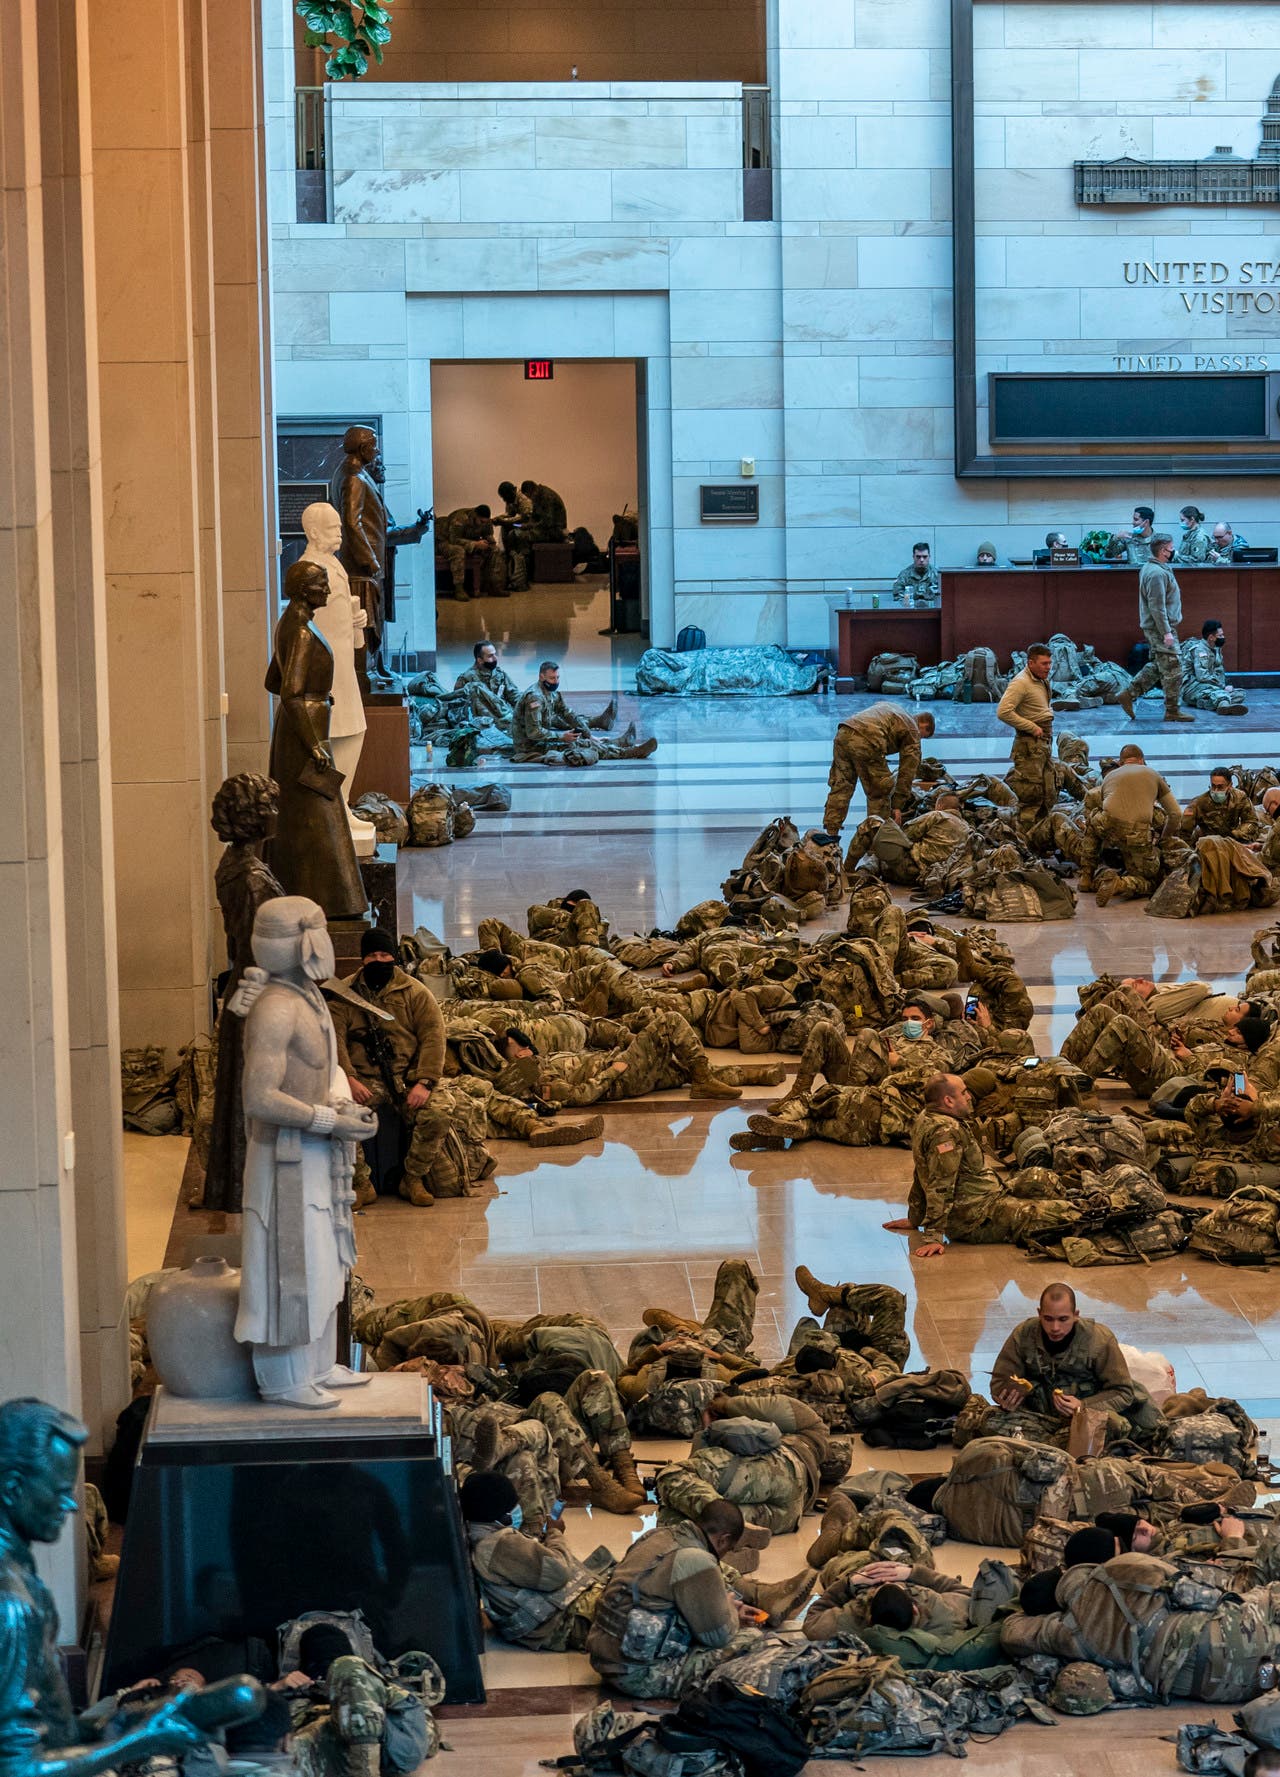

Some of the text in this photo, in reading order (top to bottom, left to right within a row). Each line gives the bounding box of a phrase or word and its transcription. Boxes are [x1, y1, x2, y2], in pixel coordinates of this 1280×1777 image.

[1122, 262, 1229, 284] UNITED
[528, 361, 550, 379] EXIT
[1112, 356, 1183, 372] TIMED
[1194, 355, 1269, 372] PASSES
